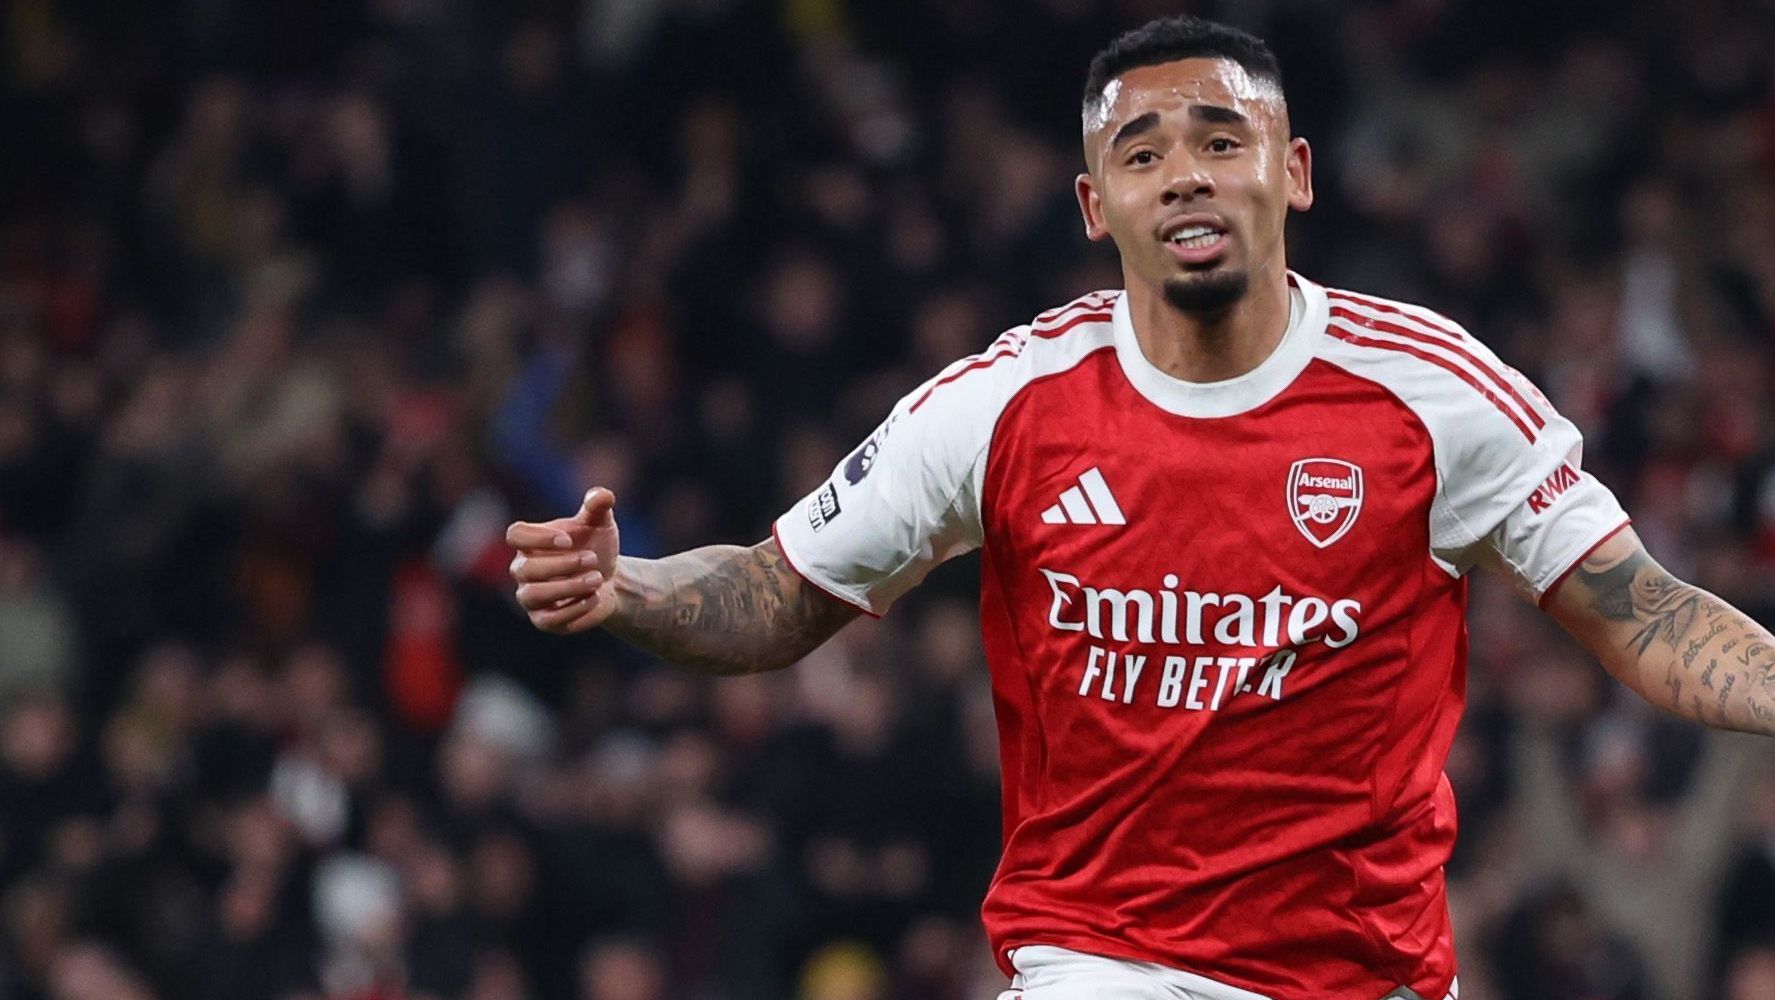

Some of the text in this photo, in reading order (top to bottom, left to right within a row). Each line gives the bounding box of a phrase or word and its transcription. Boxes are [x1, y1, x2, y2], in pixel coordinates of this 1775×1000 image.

[1299, 472, 1353, 490] Arsenal
[1038, 568, 1361, 648] Emirates
[1078, 646, 1297, 712] FLY BETTR
